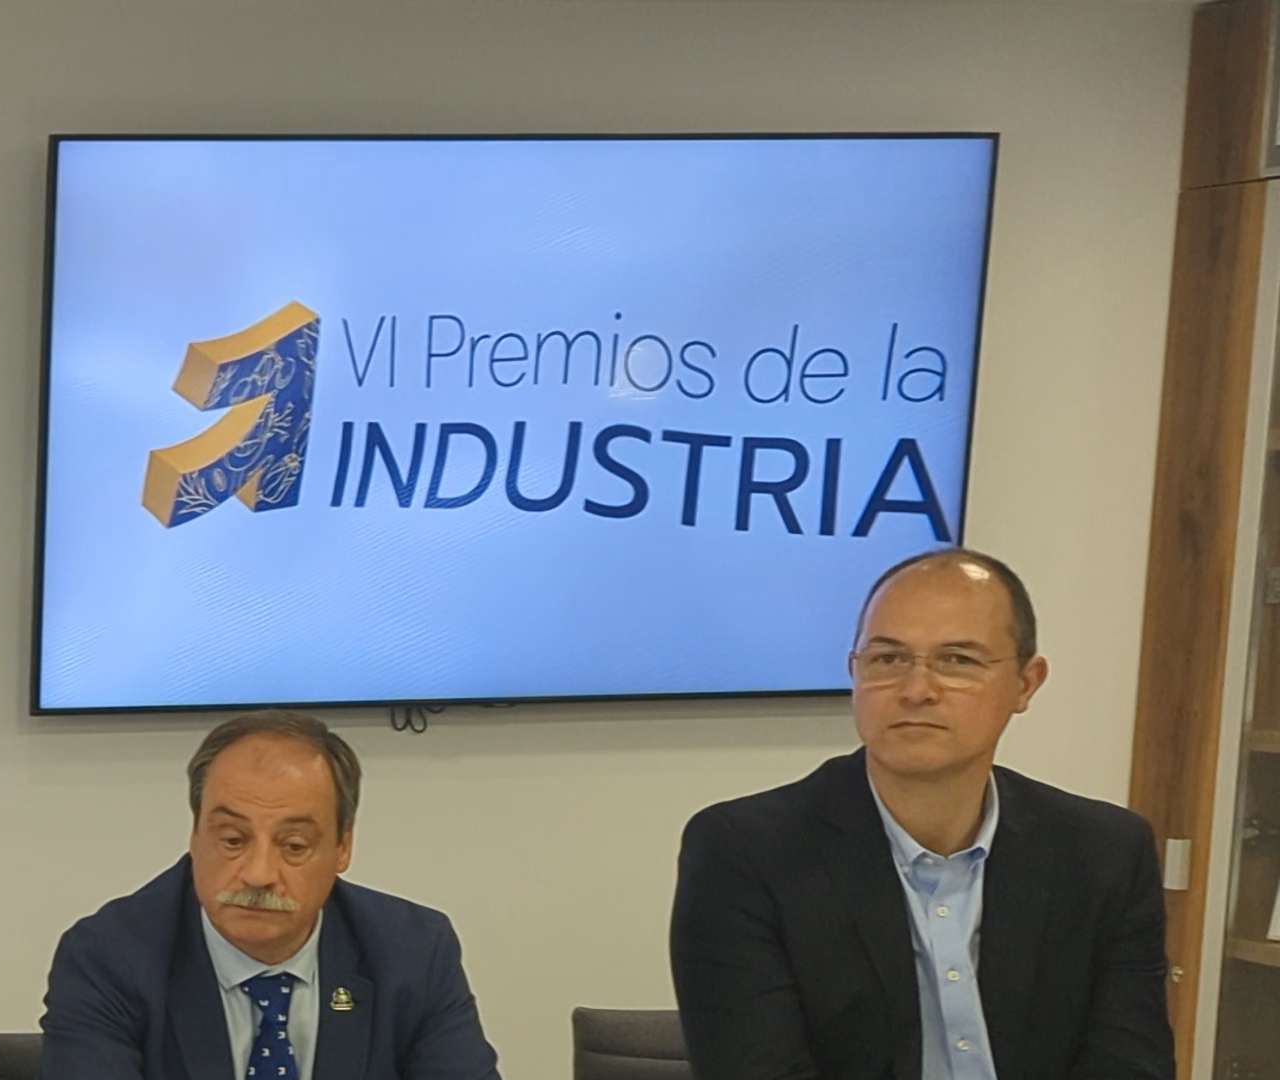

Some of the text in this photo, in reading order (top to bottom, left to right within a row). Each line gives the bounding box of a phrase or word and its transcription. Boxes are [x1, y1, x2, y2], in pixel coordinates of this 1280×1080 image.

[342, 312, 948, 404] VI Premios de la
[329, 420, 953, 543] INDUSTRIA
